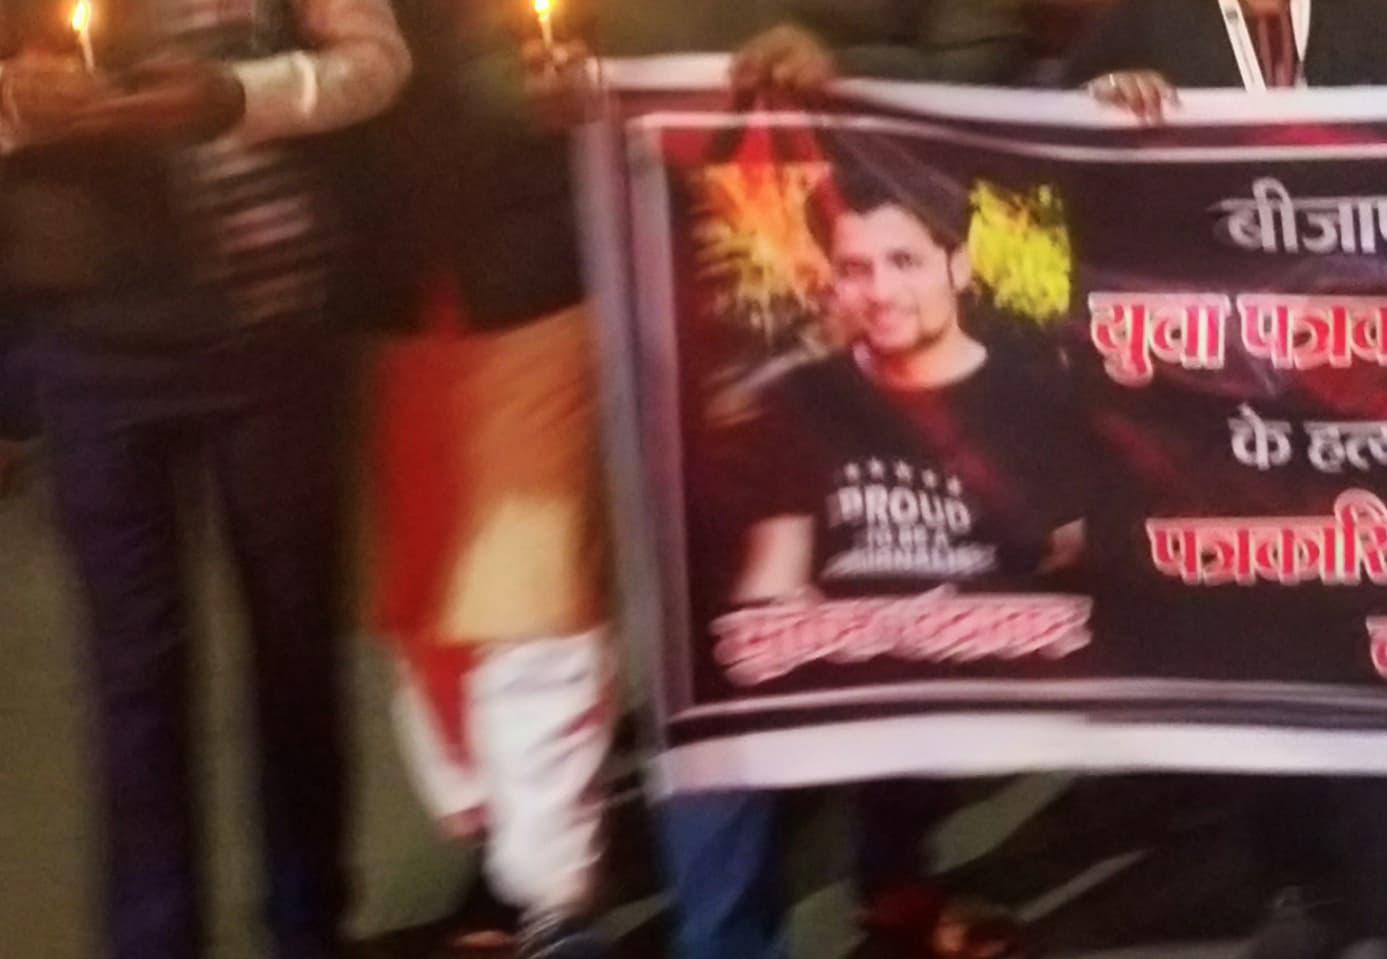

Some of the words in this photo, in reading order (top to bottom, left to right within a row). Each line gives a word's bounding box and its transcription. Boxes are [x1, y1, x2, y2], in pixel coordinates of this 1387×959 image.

[1089, 290, 1230, 386] युवा
[1228, 404, 1292, 470] के
[832, 484, 972, 535] PROUD
